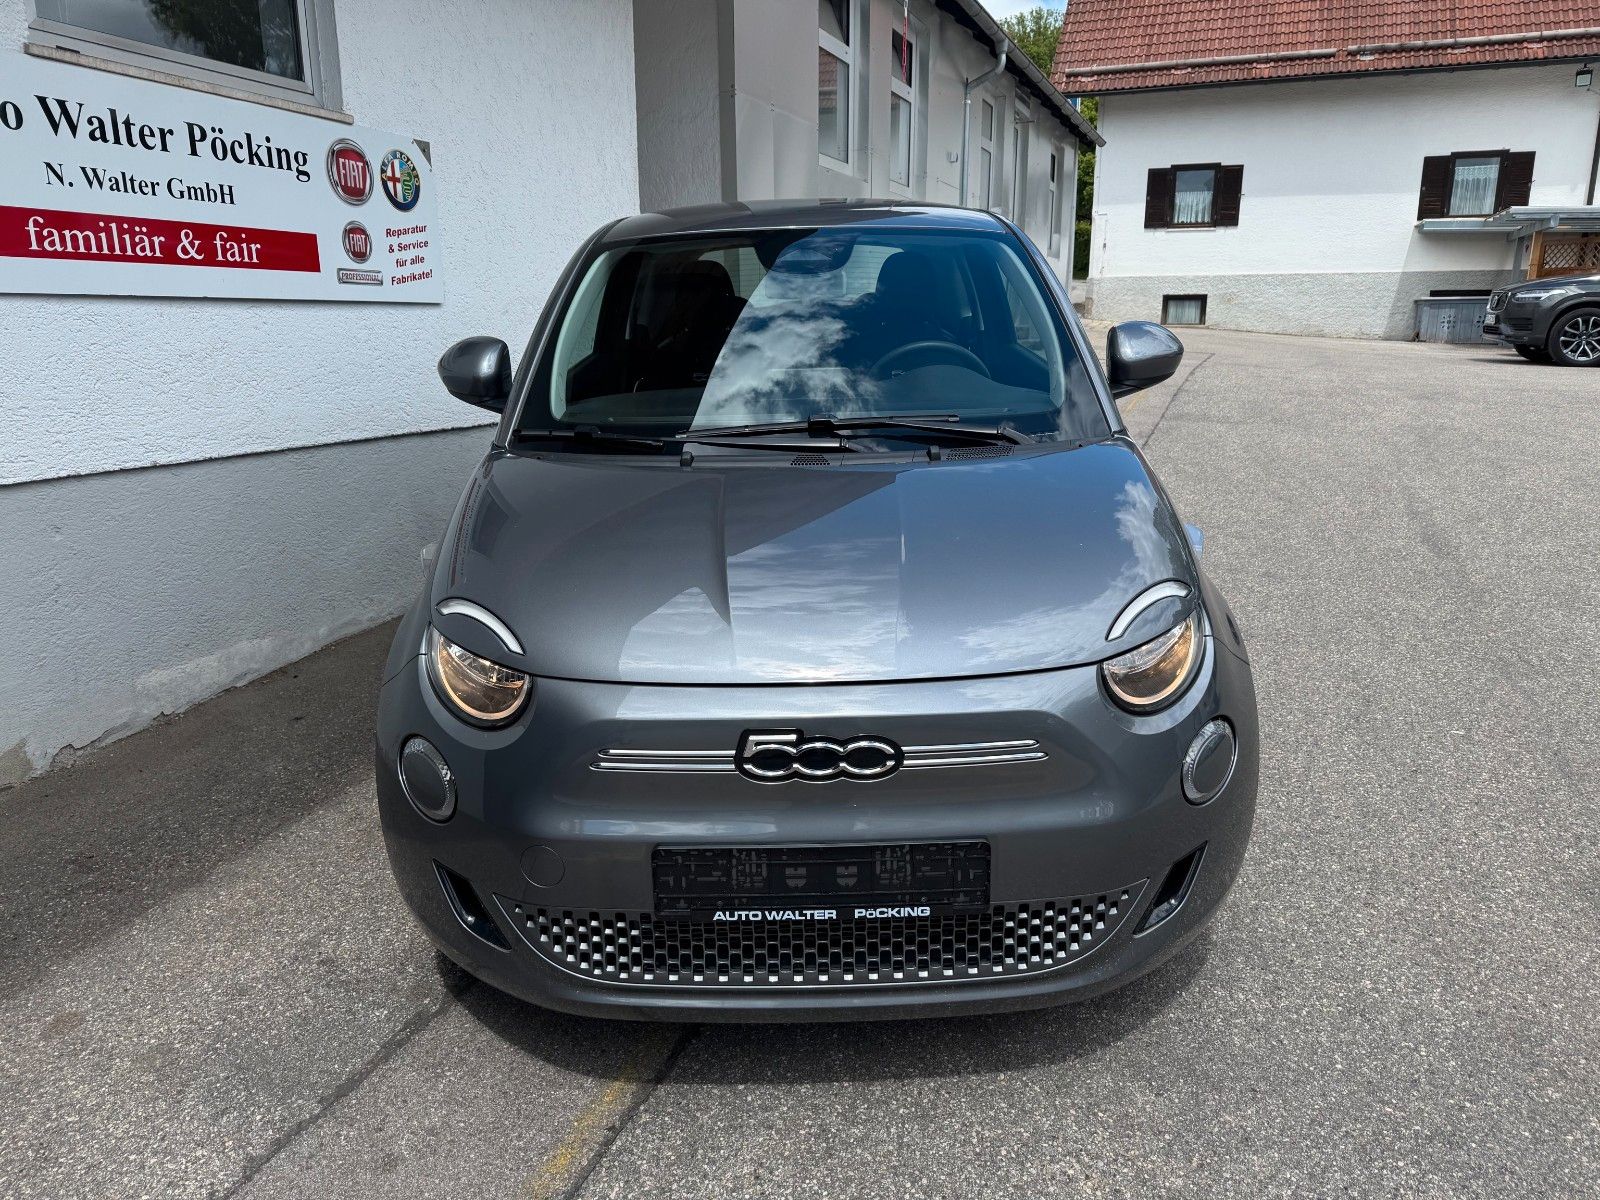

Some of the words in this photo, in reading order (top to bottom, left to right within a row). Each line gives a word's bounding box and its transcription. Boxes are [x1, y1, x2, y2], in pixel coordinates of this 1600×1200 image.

[0, 101, 23, 130] o
[33, 94, 174, 152] Walter
[184, 120, 311, 183] Pöcking
[338, 157, 364, 189] FIAT
[381, 154, 393, 181] ALFA
[396, 151, 420, 186] ROMEO
[43, 161, 74, 188] N.
[79, 165, 160, 197] Walter
[166, 178, 236, 206] GmbH
[24, 216, 166, 258] familiär
[176, 229, 205, 261] &
[213, 232, 262, 264] fair
[385, 224, 428, 239] Reparatur
[349, 233, 366, 252] FIAT
[388, 243, 395, 254] &
[397, 239, 429, 253] Service
[395, 257, 408, 268] für
[410, 255, 425, 266] alle
[341, 271, 381, 282] PROFESSIONAL
[391, 268, 433, 286] Fabrikate!
[741, 732, 898, 778] 500
[712, 910, 762, 922] AUTO
[764, 908, 837, 921] WALTER
